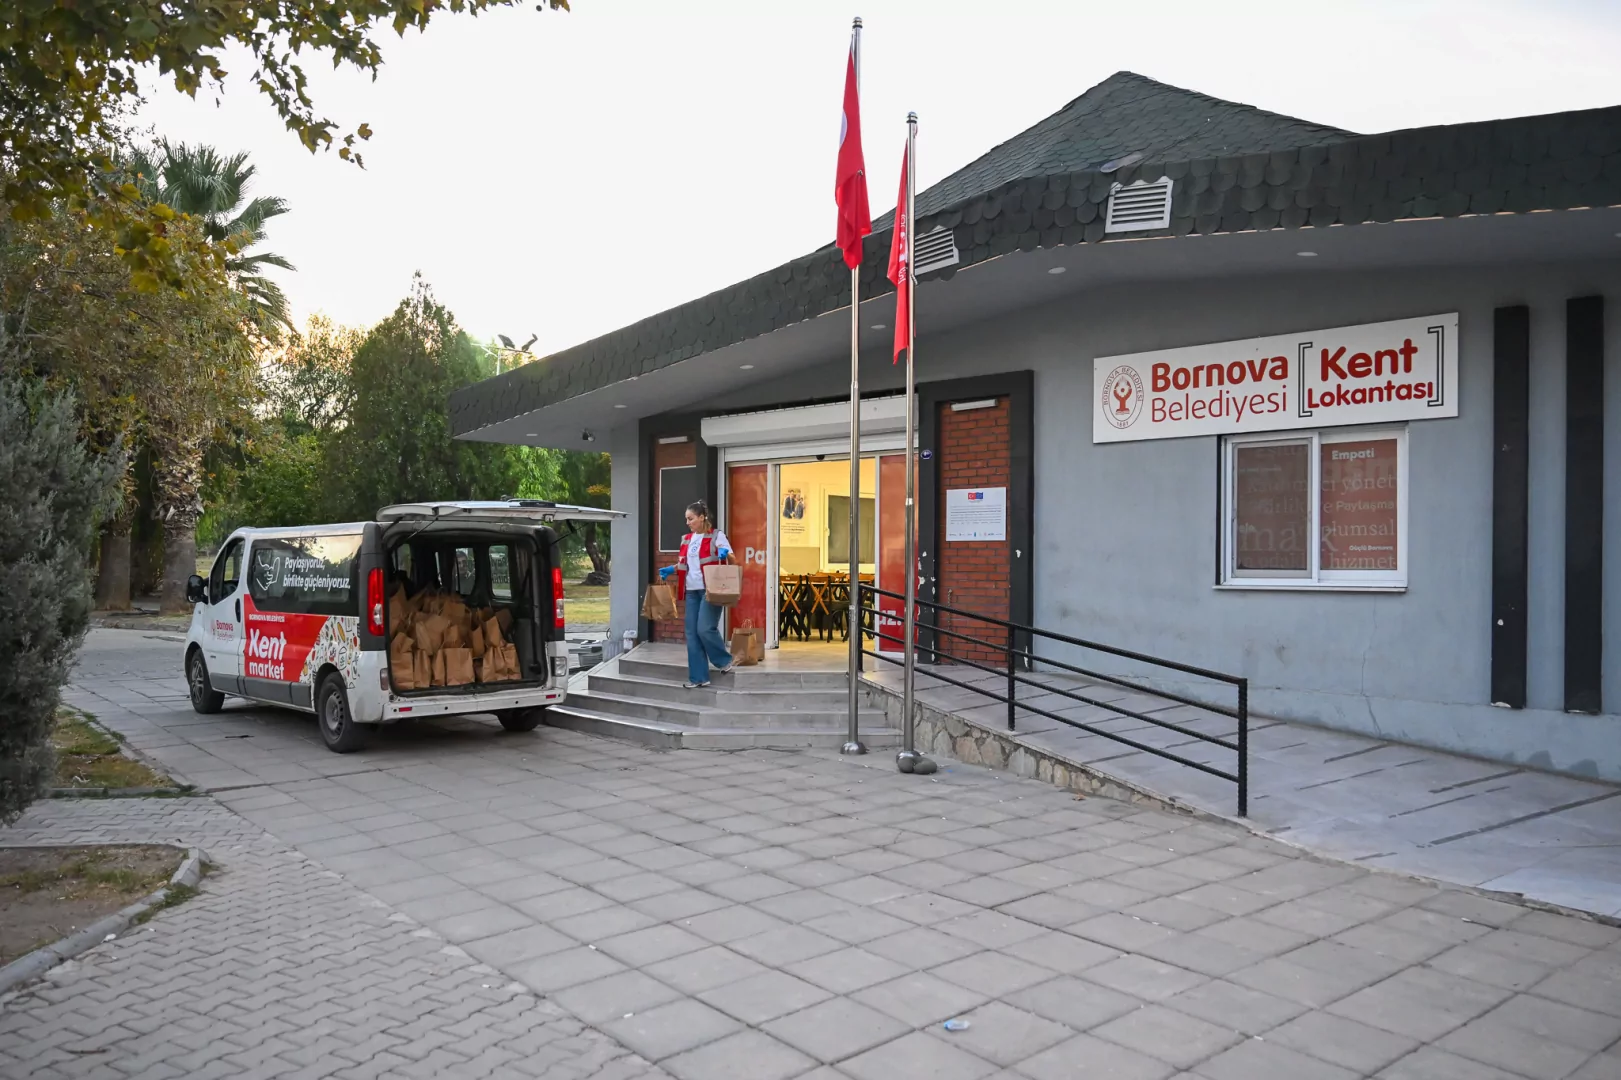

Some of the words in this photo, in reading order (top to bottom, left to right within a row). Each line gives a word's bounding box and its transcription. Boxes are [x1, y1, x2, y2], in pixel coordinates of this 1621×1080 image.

[1151, 356, 1288, 393] Bornova
[1320, 338, 1418, 381] Kent
[1151, 384, 1287, 422] Belediyesi
[1307, 379, 1433, 409] Lokantası
[1331, 448, 1374, 461] Empati
[284, 556, 325, 572] Paylaşıyoruz,
[283, 574, 304, 587] birlikte
[303, 574, 351, 592] güçleniyoruz.
[248, 628, 287, 661] Kent
[249, 659, 285, 680] market
